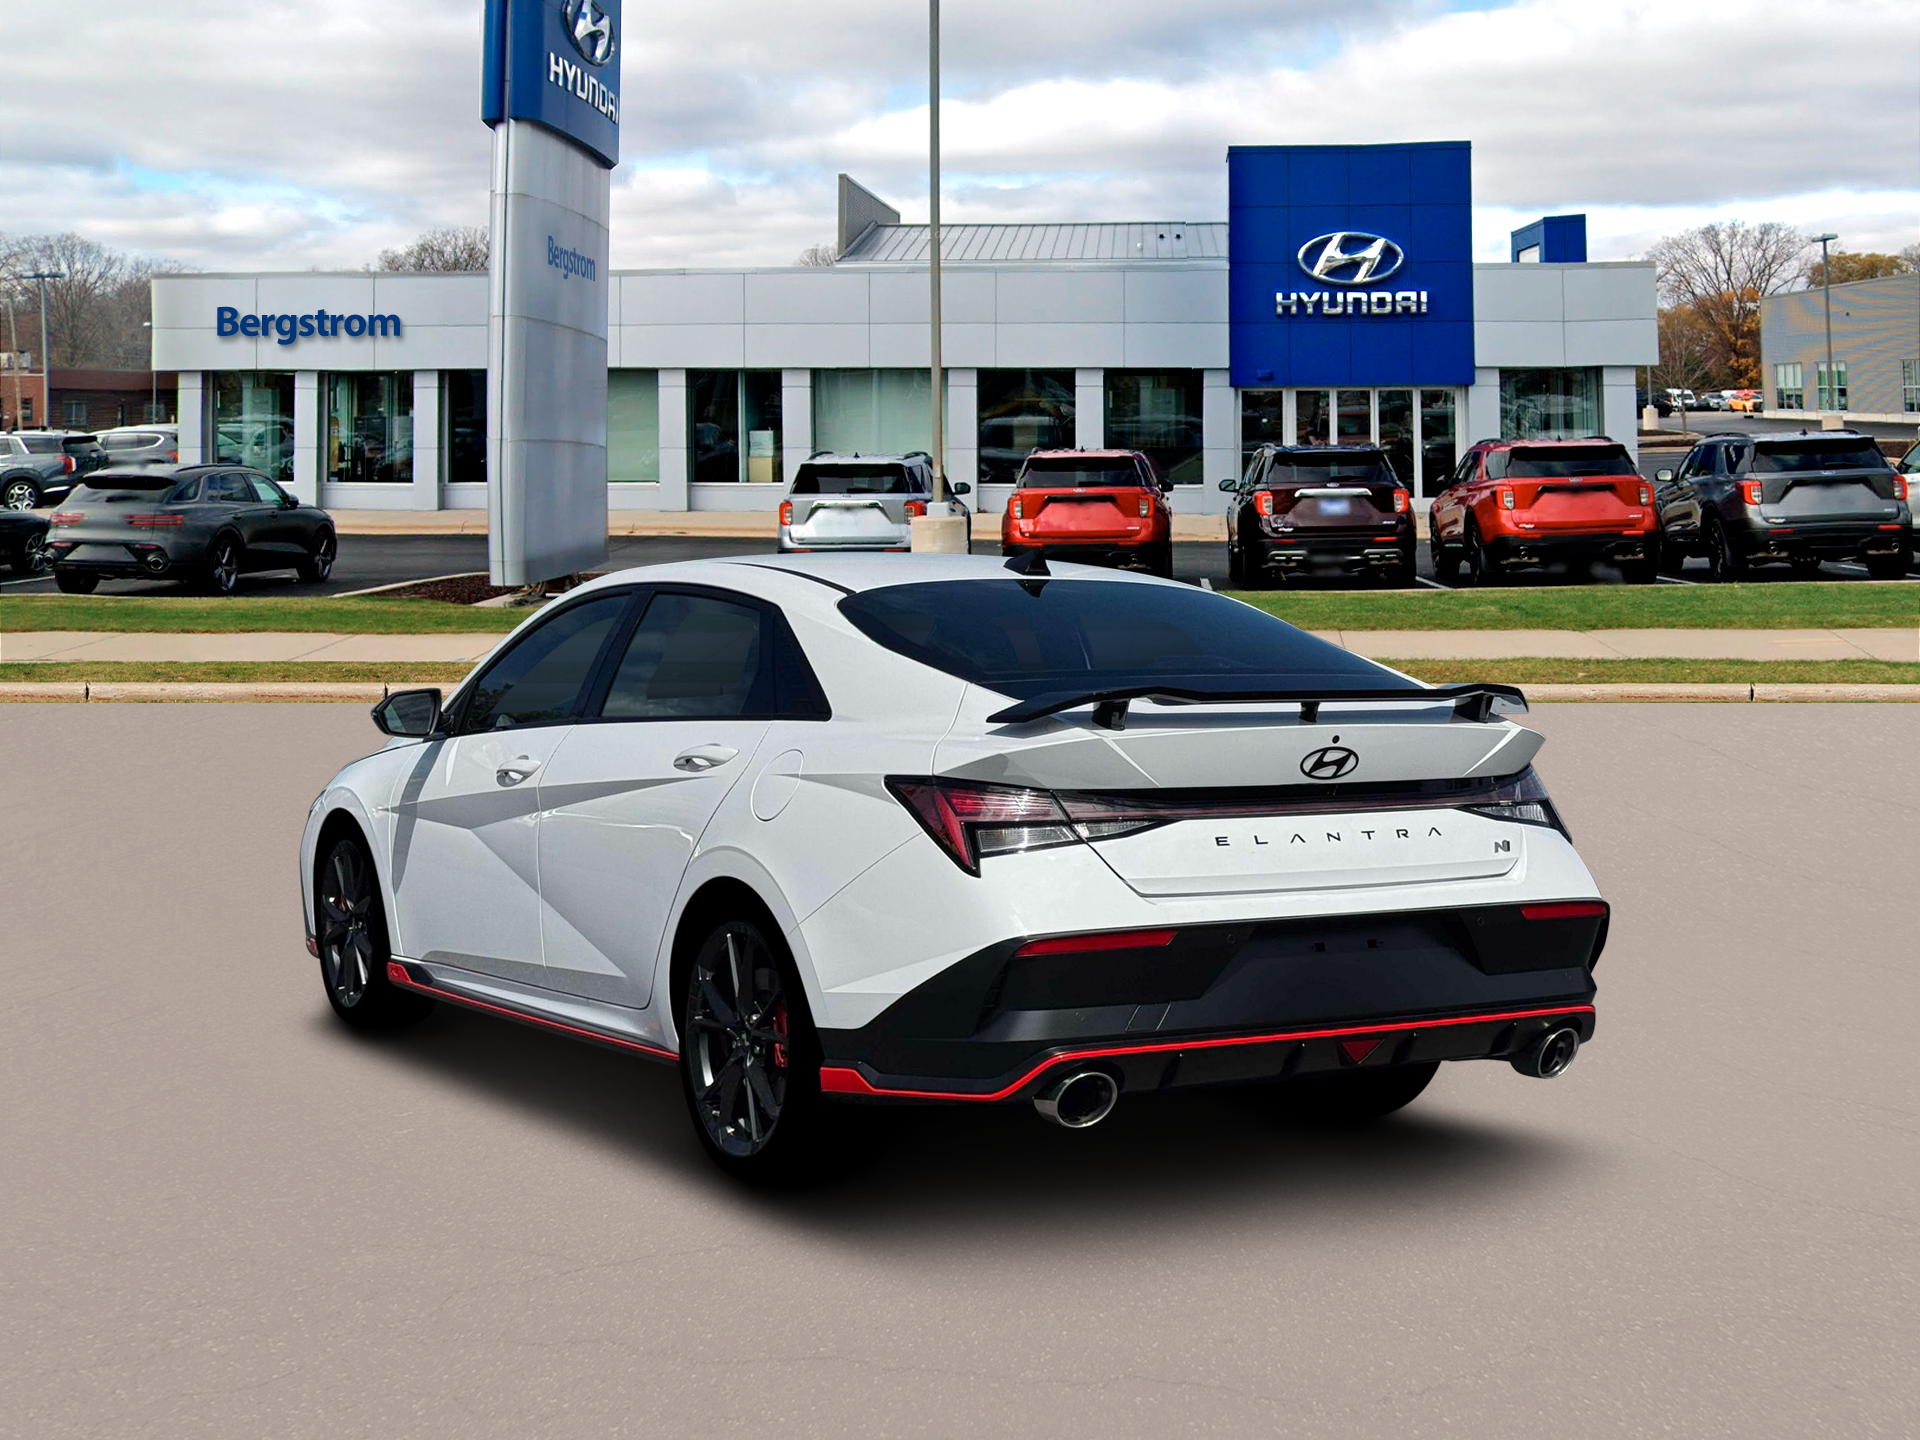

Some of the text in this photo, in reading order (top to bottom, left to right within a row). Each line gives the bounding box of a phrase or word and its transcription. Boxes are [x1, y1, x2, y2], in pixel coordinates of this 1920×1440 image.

[549, 51, 619, 124] HYUNDAI
[547, 235, 596, 282] Bergstrom
[1275, 290, 1428, 316] HYUNDAI
[216, 306, 401, 346] Bergstrom
[1214, 826, 1442, 847] ELANTRA
